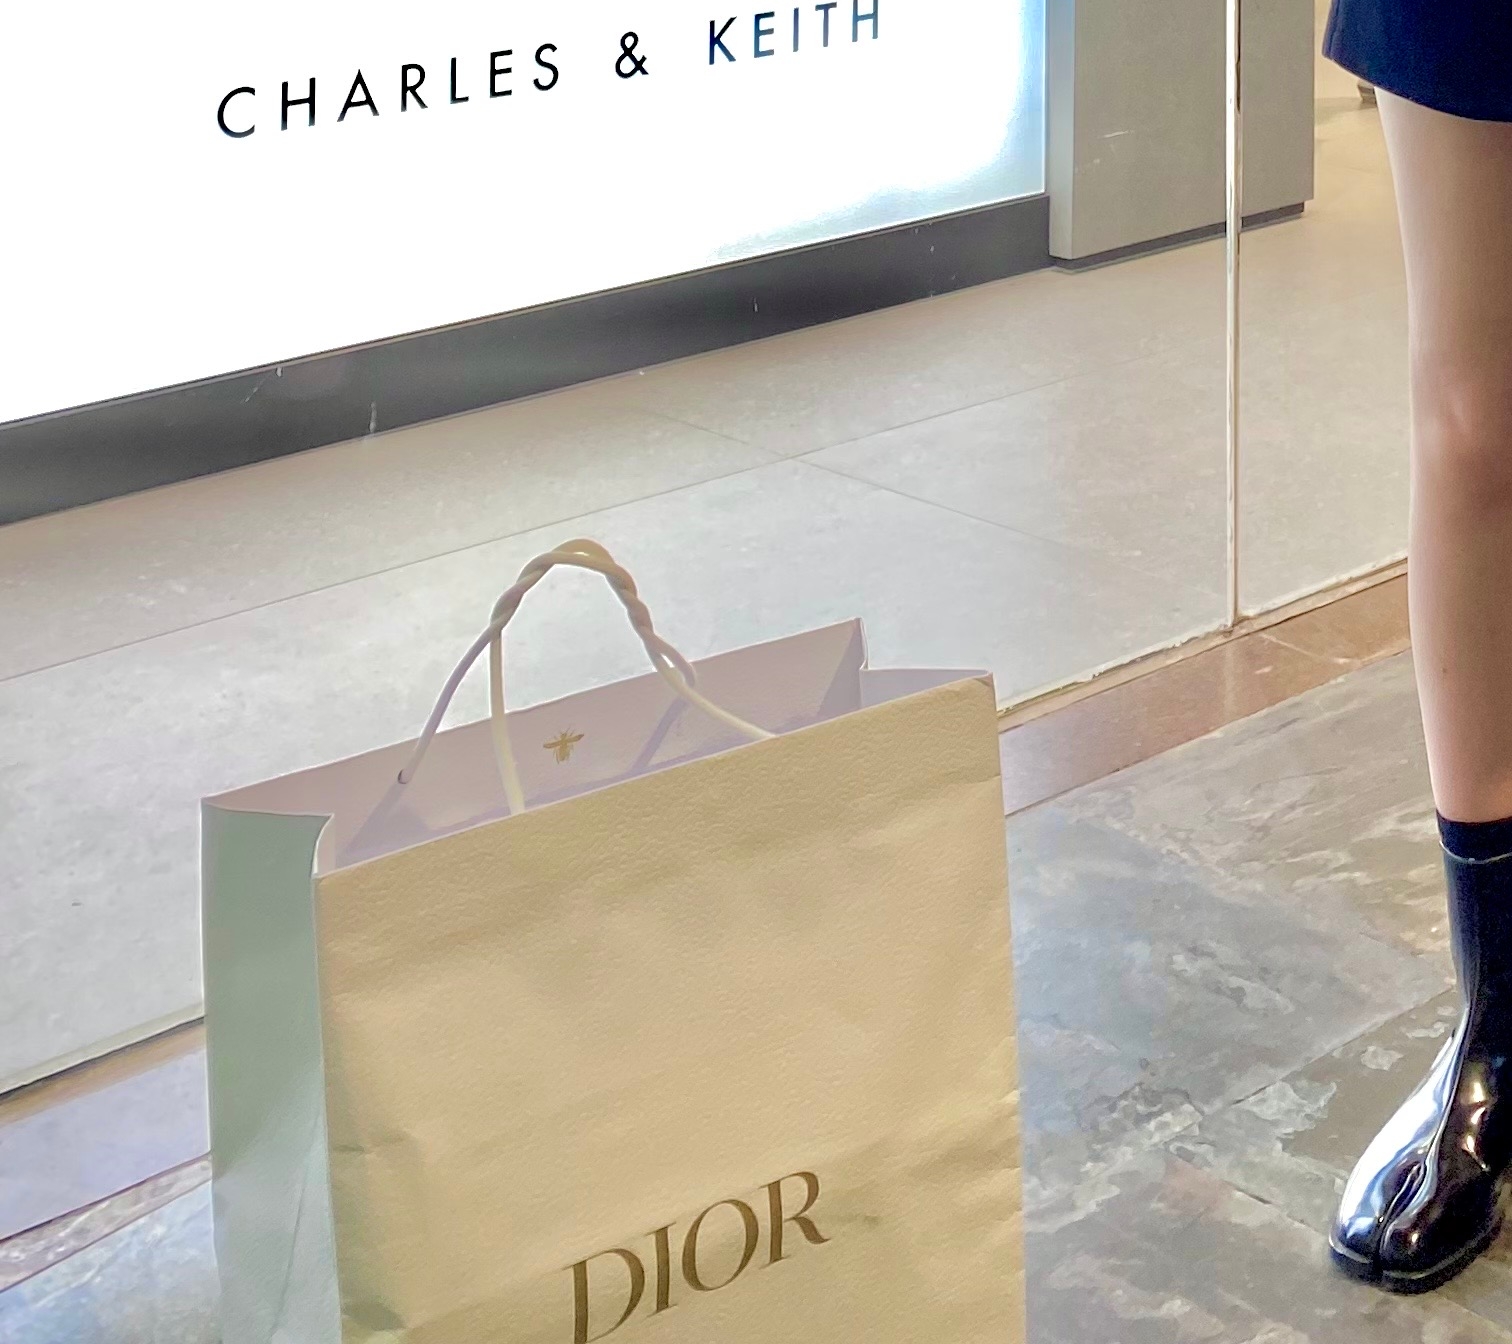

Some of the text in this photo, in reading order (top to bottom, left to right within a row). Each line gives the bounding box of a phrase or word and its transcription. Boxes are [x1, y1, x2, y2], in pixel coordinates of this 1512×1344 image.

[216, 42, 560, 140] CHARLES
[615, 31, 649, 79] &
[563, 1169, 831, 1344] DIOR
